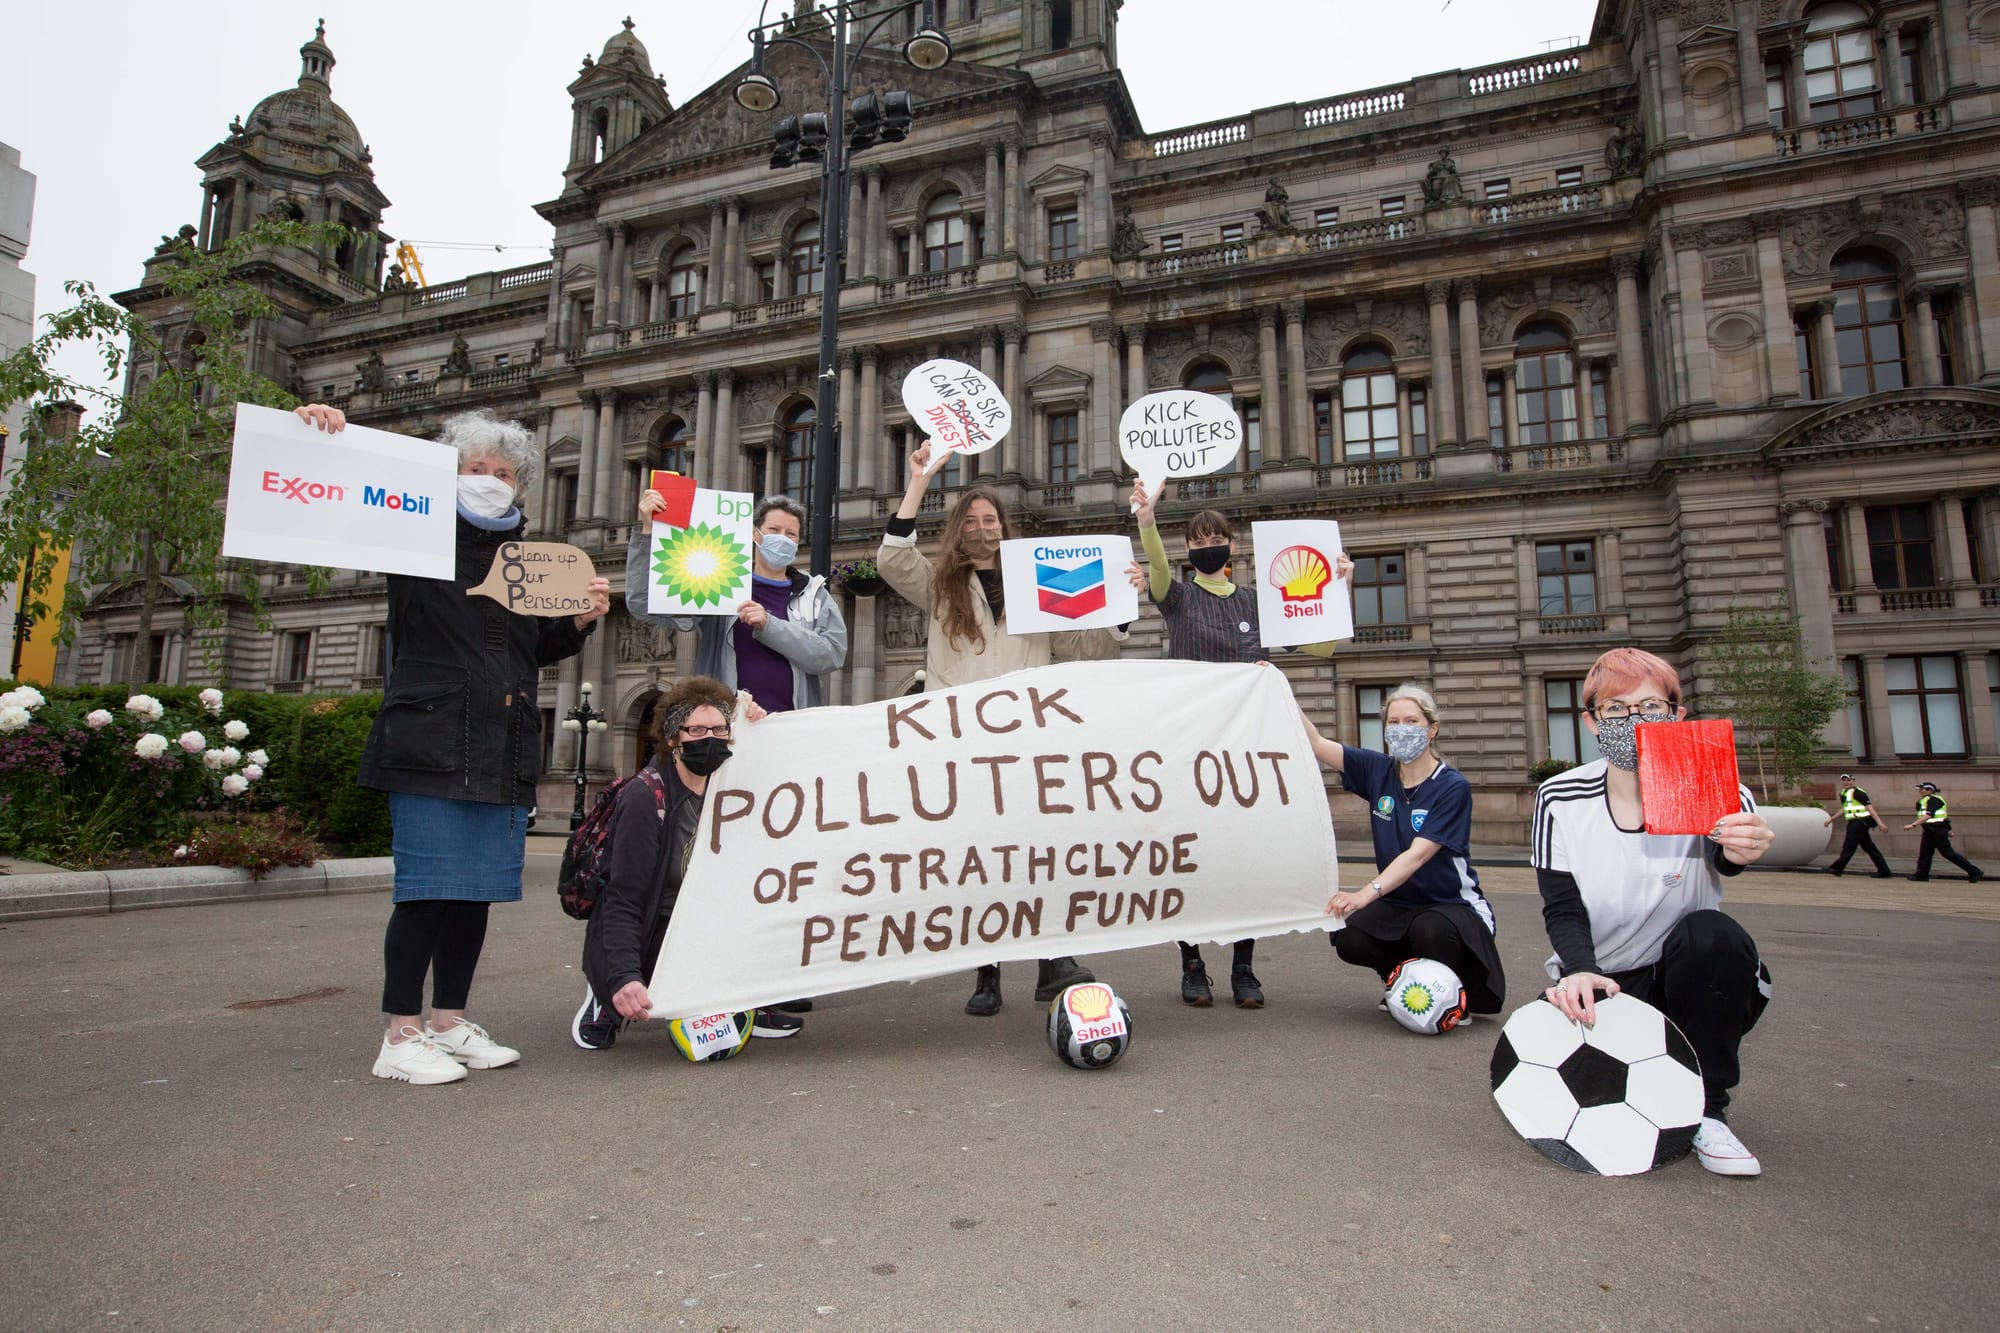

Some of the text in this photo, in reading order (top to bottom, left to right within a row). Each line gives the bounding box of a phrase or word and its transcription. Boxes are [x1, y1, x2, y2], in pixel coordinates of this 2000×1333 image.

[921, 366, 936, 374] I
[930, 374, 961, 399] CAN
[952, 369, 986, 396] YES
[1145, 400, 1199, 425] KICK
[925, 406, 967, 449] DIVEST
[1126, 420, 1236, 450] POLLUTERS
[1167, 446, 1217, 471] OUT
[262, 471, 429, 515] Exxon Mobil
[716, 494, 753, 522] bp
[501, 542, 577, 570] Clean up
[1034, 547, 1102, 560] Chevron
[502, 562, 550, 583] Our
[507, 584, 591, 610] Pensions
[1283, 602, 1323, 618] $hell
[887, 686, 1085, 749] KICK
[709, 750, 1290, 855] POLLUTERS OUT
[754, 832, 1199, 904] OF STRATHCLYDE
[801, 887, 1185, 967] PENSION FUND
[696, 1023, 731, 1045] Mobil
[1076, 1021, 1123, 1042] Shell
